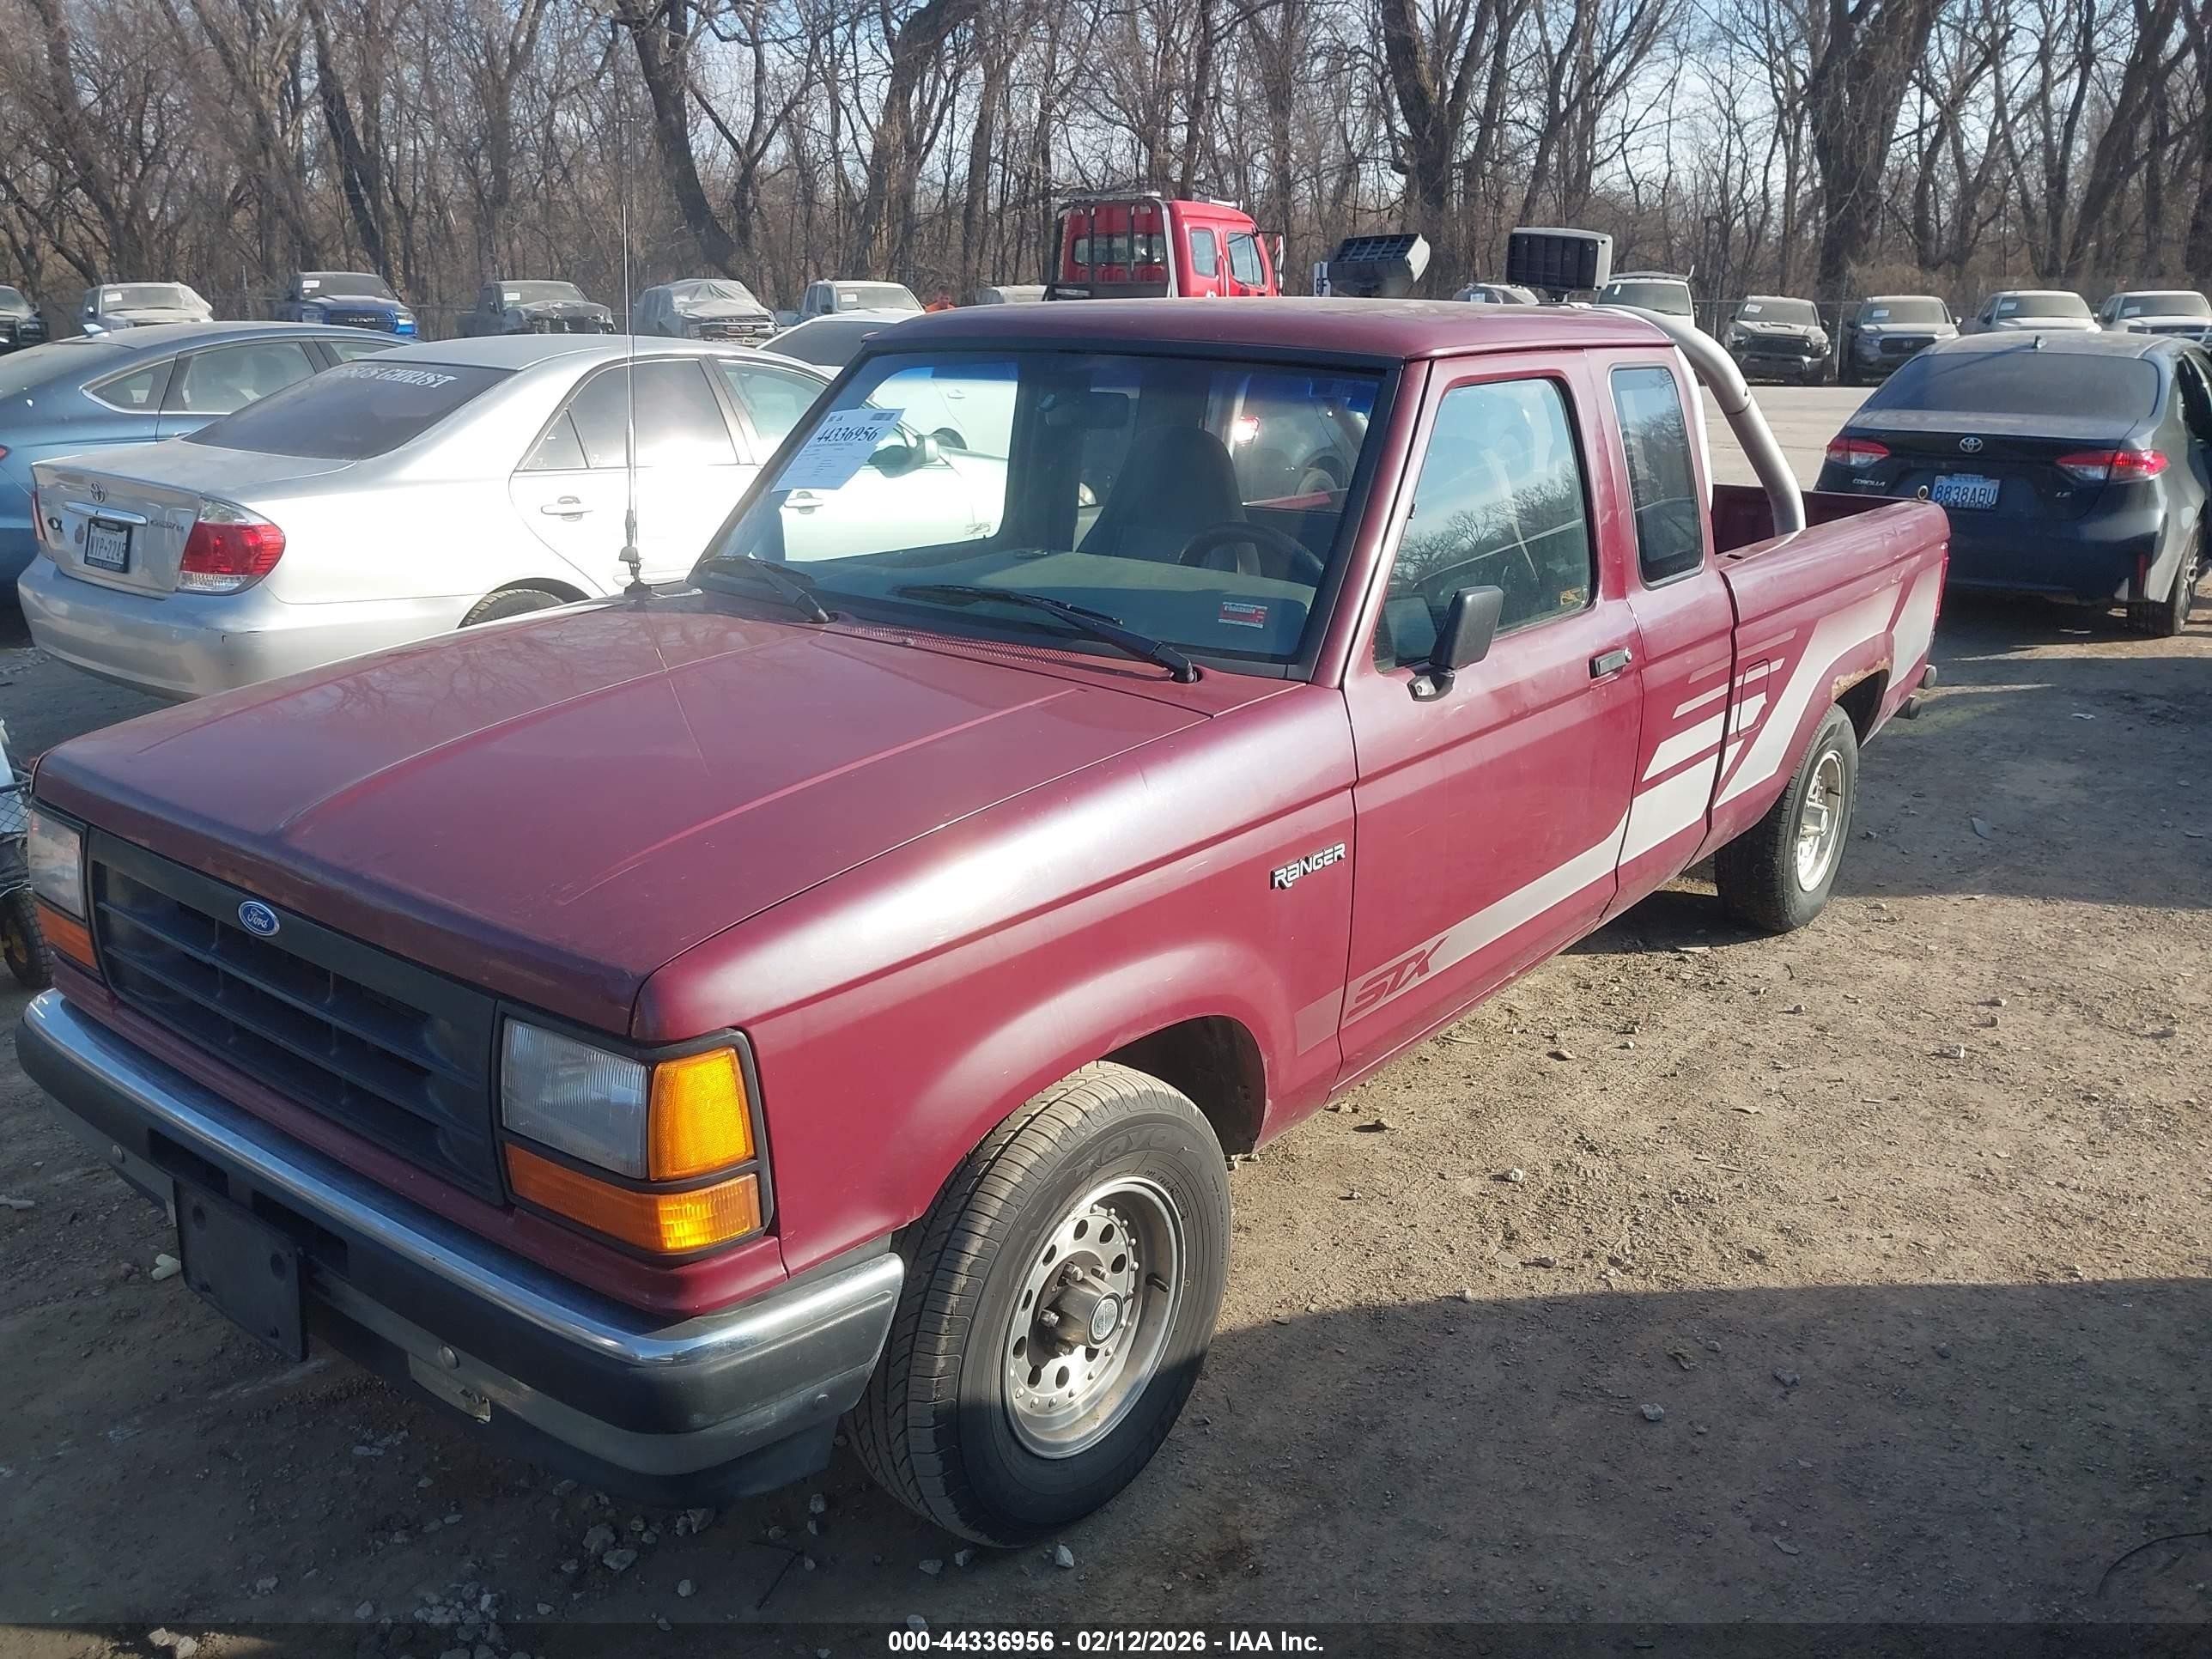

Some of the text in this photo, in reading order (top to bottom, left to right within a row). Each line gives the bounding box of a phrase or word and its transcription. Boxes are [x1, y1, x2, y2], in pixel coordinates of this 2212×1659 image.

[375, 368, 459, 388] CHRIST
[817, 426, 884, 442] 44336956
[1852, 477, 1887, 487] COROLLA
[1935, 484, 1996, 505] 8838ABU
[1270, 842, 1346, 890] RANGER
[247, 907, 270, 928] Ford
[1345, 935, 1449, 1021] STX
